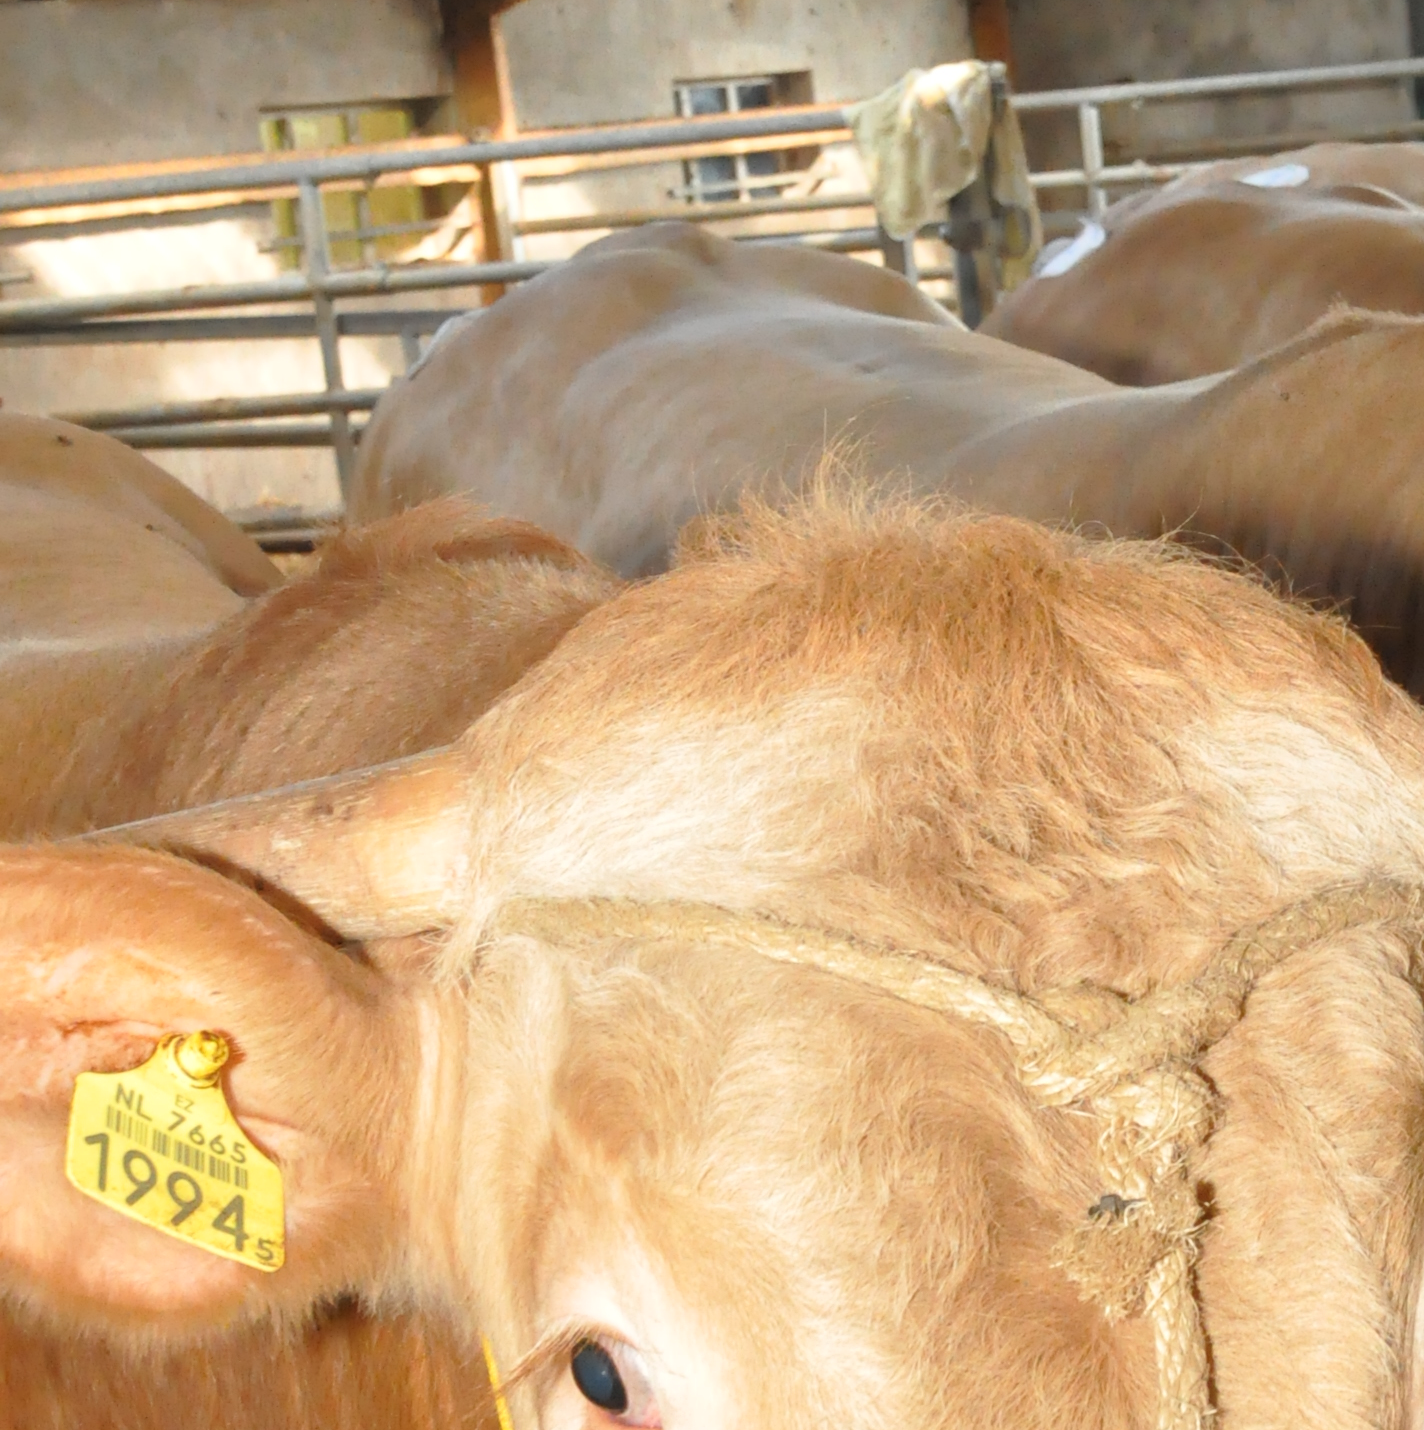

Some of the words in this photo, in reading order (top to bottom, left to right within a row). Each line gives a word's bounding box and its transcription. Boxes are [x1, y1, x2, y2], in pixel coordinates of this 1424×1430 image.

[116, 1083, 152, 1121] NL
[168, 1111, 247, 1163] 7665
[85, 1133, 249, 1252] 1994
